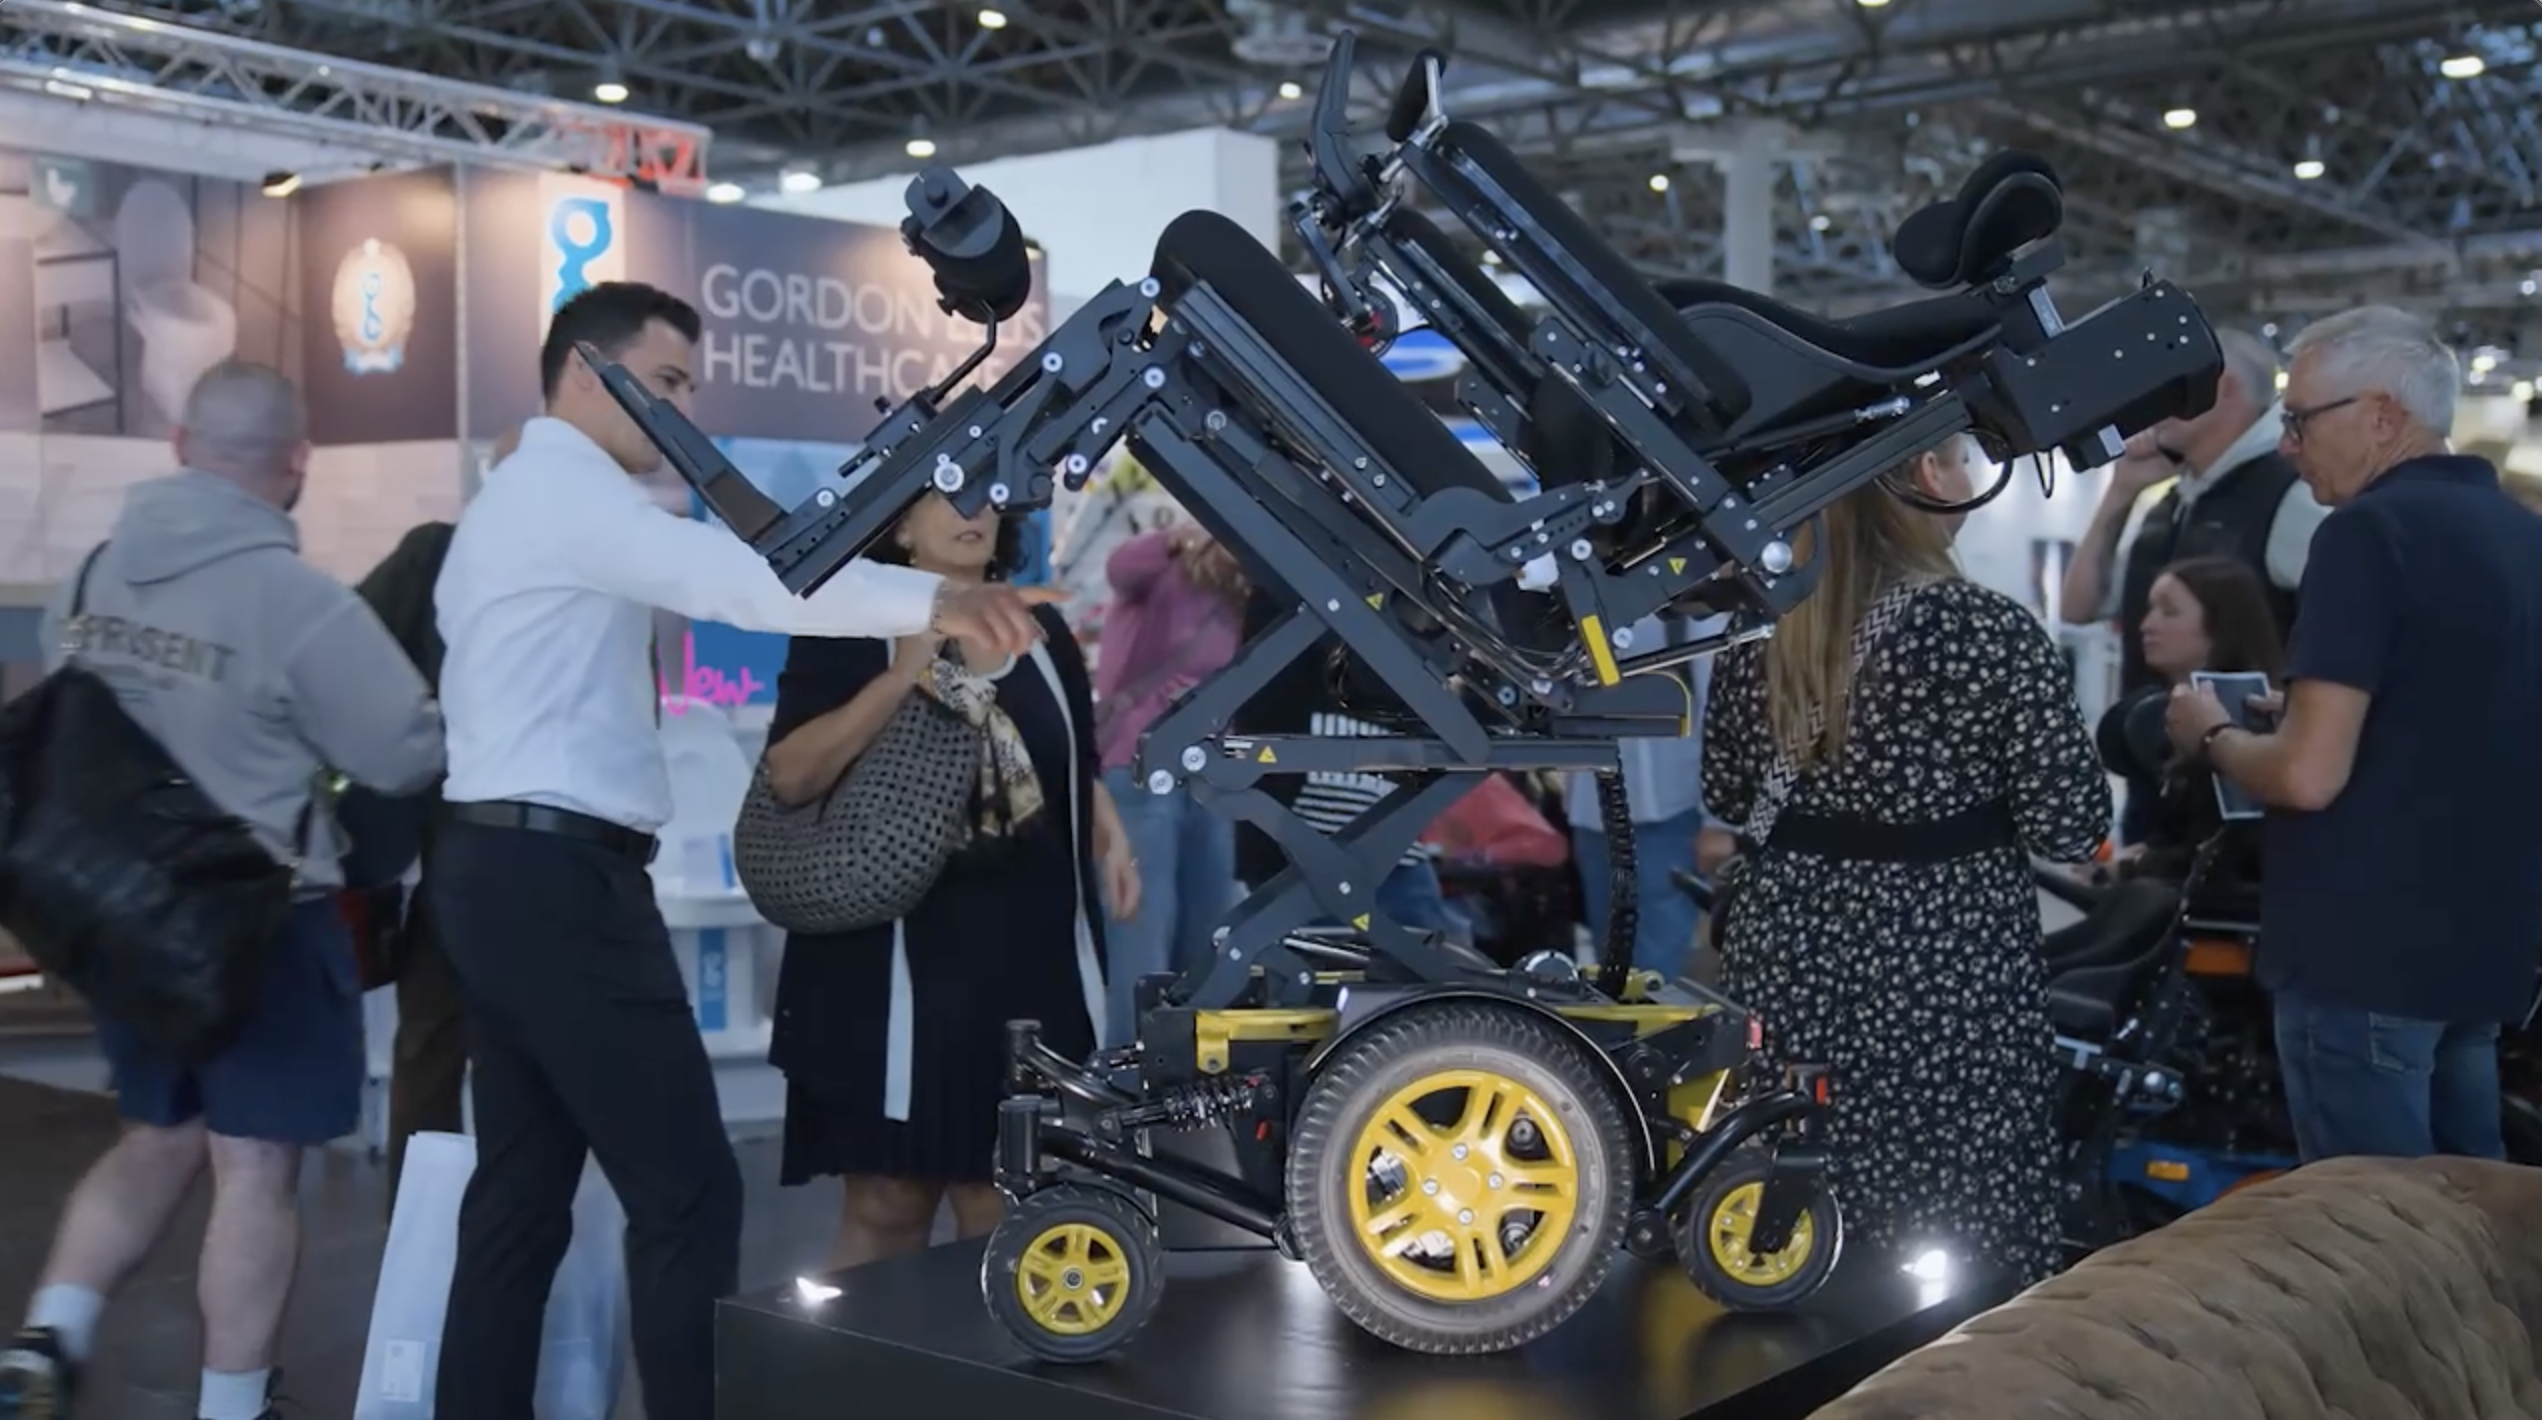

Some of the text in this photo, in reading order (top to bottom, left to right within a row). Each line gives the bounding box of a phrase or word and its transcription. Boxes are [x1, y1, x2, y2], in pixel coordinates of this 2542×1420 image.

[702, 264, 1045, 348] GORDON ELIS
[703, 331, 1005, 402] HEALTHCAE
